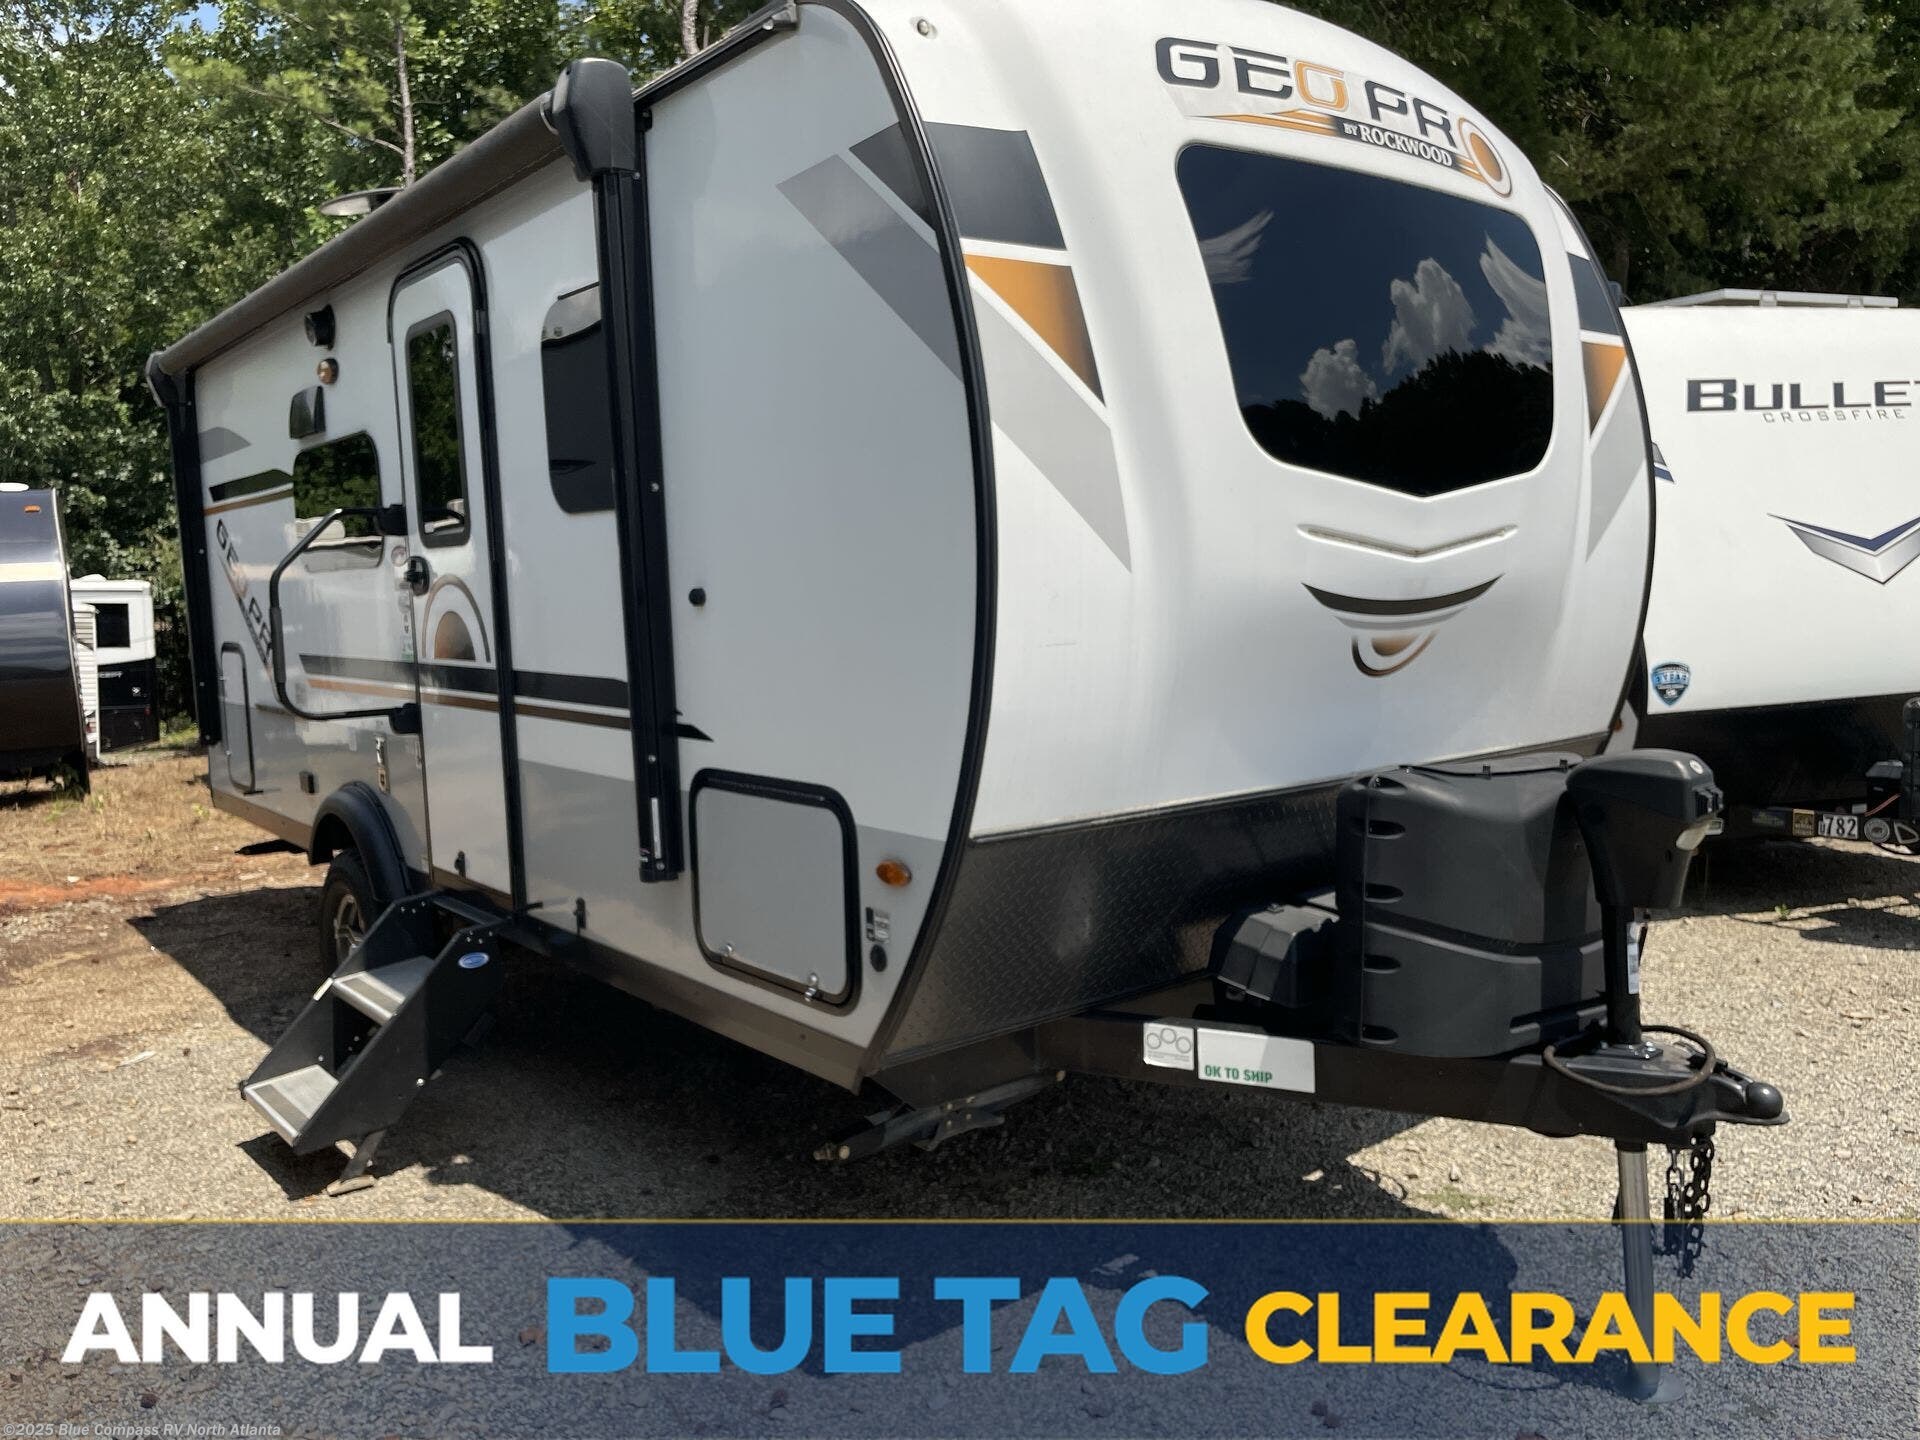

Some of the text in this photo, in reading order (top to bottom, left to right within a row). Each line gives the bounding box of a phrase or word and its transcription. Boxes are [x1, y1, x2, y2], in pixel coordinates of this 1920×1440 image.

[1155, 37, 1513, 198] GEO PRO
[1343, 122, 1453, 167] BY ROCKWOOD
[1762, 408, 1906, 424] CROSSFIRE
[1204, 1064, 1273, 1083] OK TO SHIP
